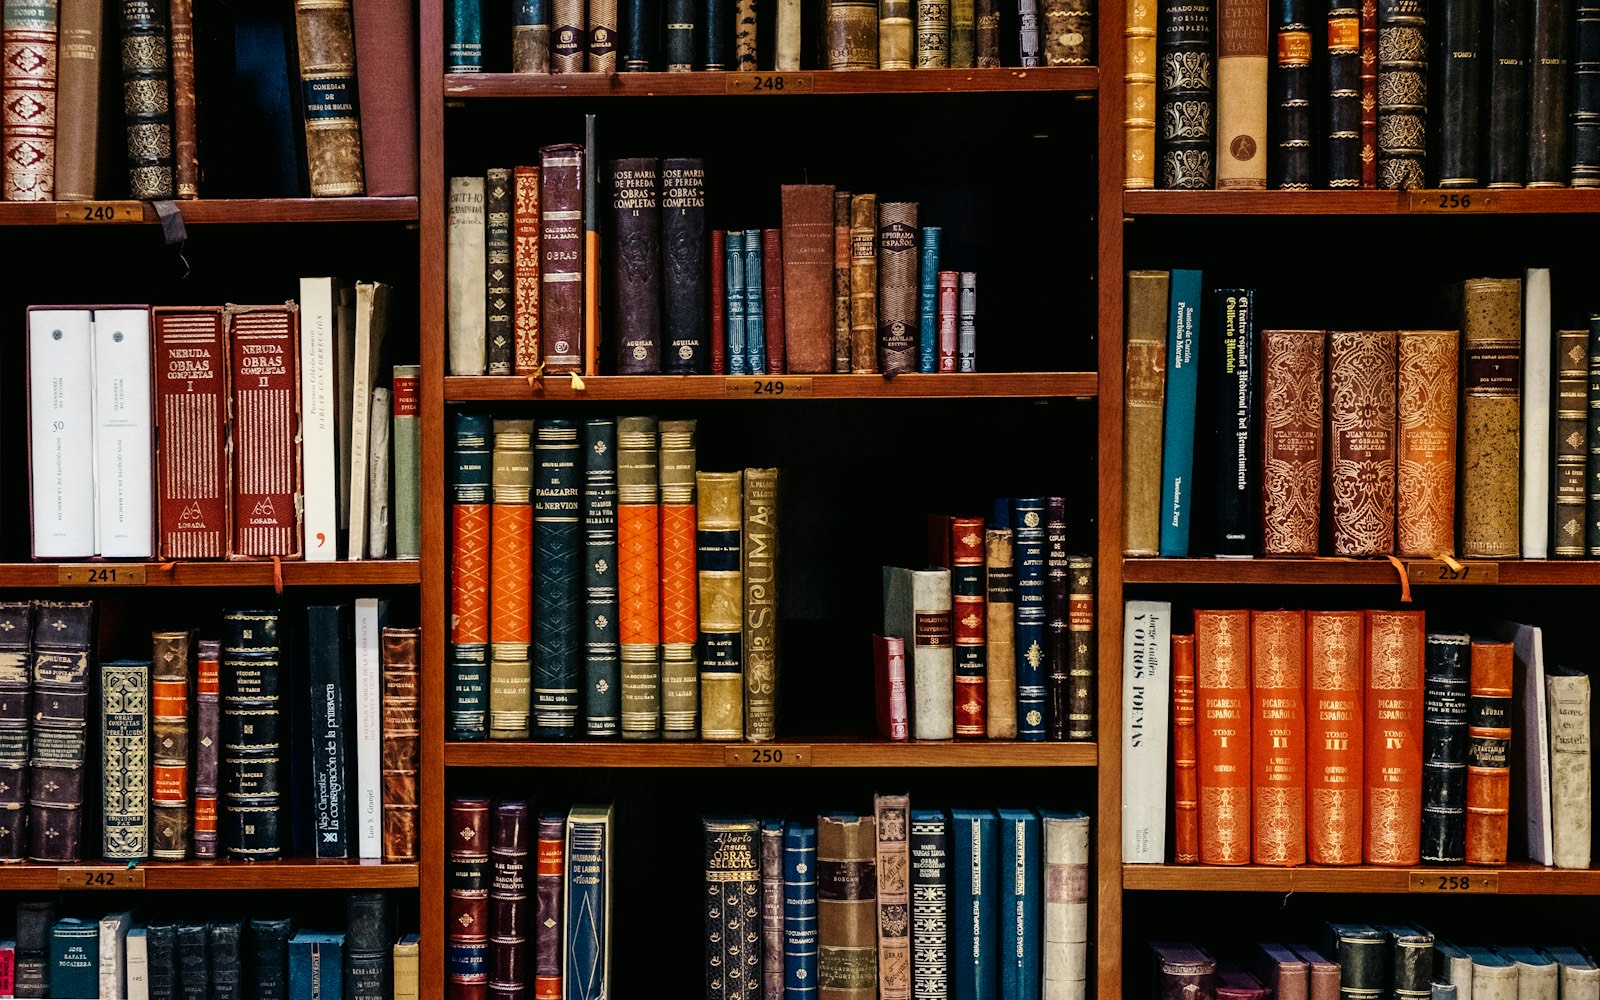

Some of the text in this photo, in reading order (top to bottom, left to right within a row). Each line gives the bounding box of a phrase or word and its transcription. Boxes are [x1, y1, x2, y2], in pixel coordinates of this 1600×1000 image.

[313, 83, 346, 91] COMEDIAS
[753, 77, 785, 91] 248
[613, 171, 632, 180] JOSE
[662, 170, 681, 179] JOSE
[615, 179, 654, 188] DE PEREDA
[664, 178, 703, 187] DE PEREDA
[620, 189, 648, 199] OBRAS
[669, 188, 697, 198] OBRAS
[614, 198, 656, 208] COMPLETAS
[663, 197, 704, 207] COMPLETAS
[1438, 194, 1470, 209] 256
[84, 206, 115, 220] 240
[632, 209, 640, 217] II
[882, 231, 915, 241] EPIGRAMA
[882, 240, 914, 250] ESPAÑOL
[546, 251, 578, 260] OBRAS
[1238, 297, 1247, 308] El
[1226, 296, 1236, 336] Edilberto
[1238, 309, 1247, 334] teatro
[1174, 302, 1185, 368] Proverbios Morales
[1184, 308, 1193, 363] Santob de Carrión
[672, 339, 699, 347] AGUILAR
[169, 349, 211, 358] NERUDA
[242, 344, 284, 355] NERUDA
[1236, 335, 1247, 367] español
[169, 361, 210, 372] OBRAS
[242, 356, 283, 367] OBRAS
[168, 370, 214, 380] COMPLETAS
[241, 366, 286, 376] COMPLETAS
[186, 381, 194, 391] I
[259, 376, 270, 388] II
[753, 381, 785, 395] 249
[1237, 370, 1247, 409] Medieval
[1237, 417, 1247, 429] del
[1273, 430, 1317, 438] JUAN VALERA
[1346, 430, 1388, 438] JUAN VALERA
[1237, 432, 1247, 490] Renacimiento
[536, 488, 578, 496] PAGAZARRI
[250, 517, 278, 525] LOSADA
[1048, 534, 1066, 542] COPLAS
[1053, 542, 1061, 550] DE
[89, 569, 117, 583] 241
[1147, 613, 1159, 676] Jorge Guillén
[1131, 614, 1146, 748] Y OTROS POEMAS
[53, 701, 59, 709] 2
[1206, 698, 1242, 708] PICARESCA
[1262, 698, 1297, 708] PICARESCA
[1319, 700, 1354, 710] PICARESCA
[1378, 699, 1412, 709] PICARESCA
[1207, 709, 1241, 719] ESPAÑOLA
[1262, 709, 1296, 719] ESPAÑOLA
[1320, 710, 1353, 720] ESPAÑOLA
[1378, 709, 1411, 720] ESPAÑOLA
[1220, 736, 1228, 748] I
[1273, 736, 1288, 748] II
[1324, 738, 1348, 750] III
[1386, 737, 1404, 749] IV
[325, 683, 342, 831] La consagración de la primavera
[752, 749, 783, 763] 250
[1213, 764, 1236, 772] QUEVEDO
[1325, 766, 1349, 774] QUEVEDO
[317, 772, 330, 831] Alejo Carpentier
[367, 789, 375, 814] Granjel
[714, 832, 753, 843] Alberto
[719, 842, 747, 852] Insua
[714, 851, 752, 860] OBRAS
[710, 860, 757, 869] SELECTAS
[85, 872, 115, 886] 242
[1438, 876, 1470, 890] 258
